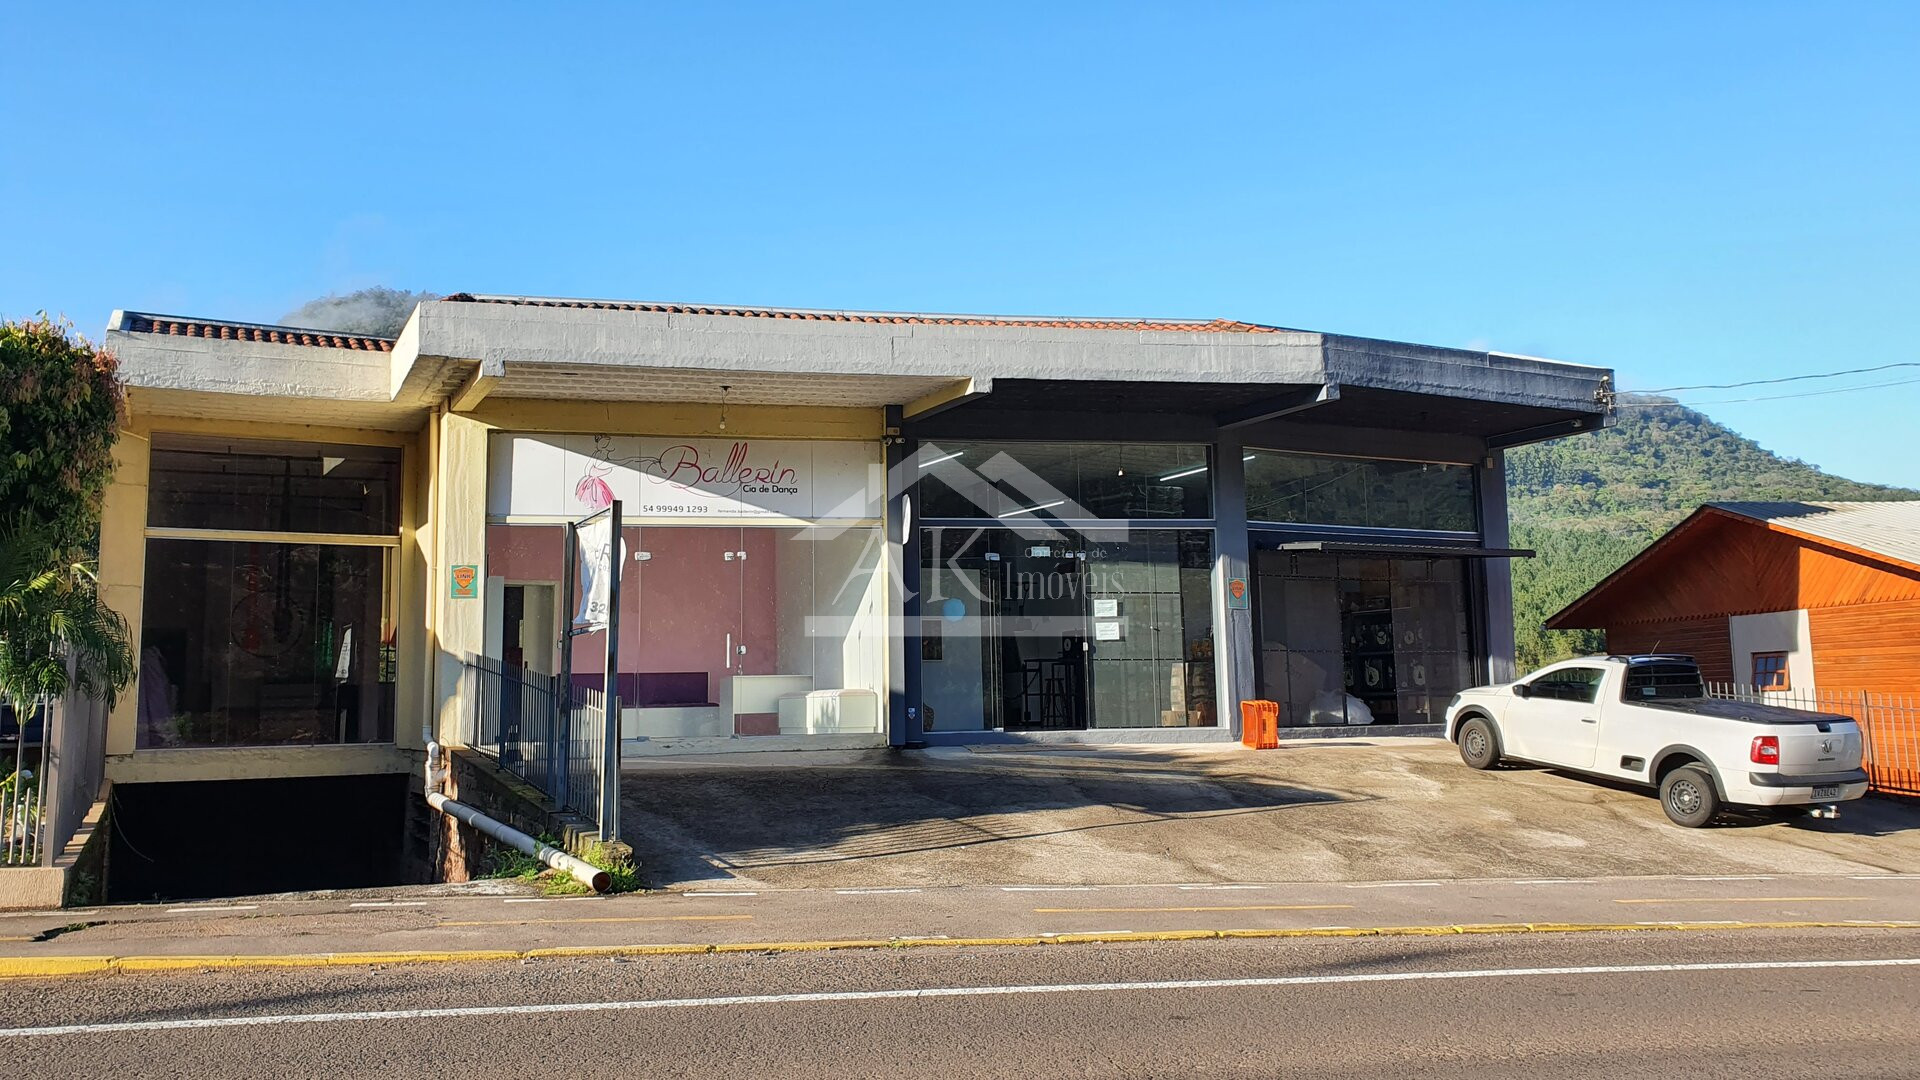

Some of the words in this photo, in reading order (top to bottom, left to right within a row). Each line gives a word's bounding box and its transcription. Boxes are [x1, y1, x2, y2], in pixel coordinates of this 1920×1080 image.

[742, 485, 757, 493] Cia
[759, 485, 770, 493] de
[772, 485, 798, 495] Dança
[643, 505, 654, 513] 54
[656, 505, 684, 513] 99949
